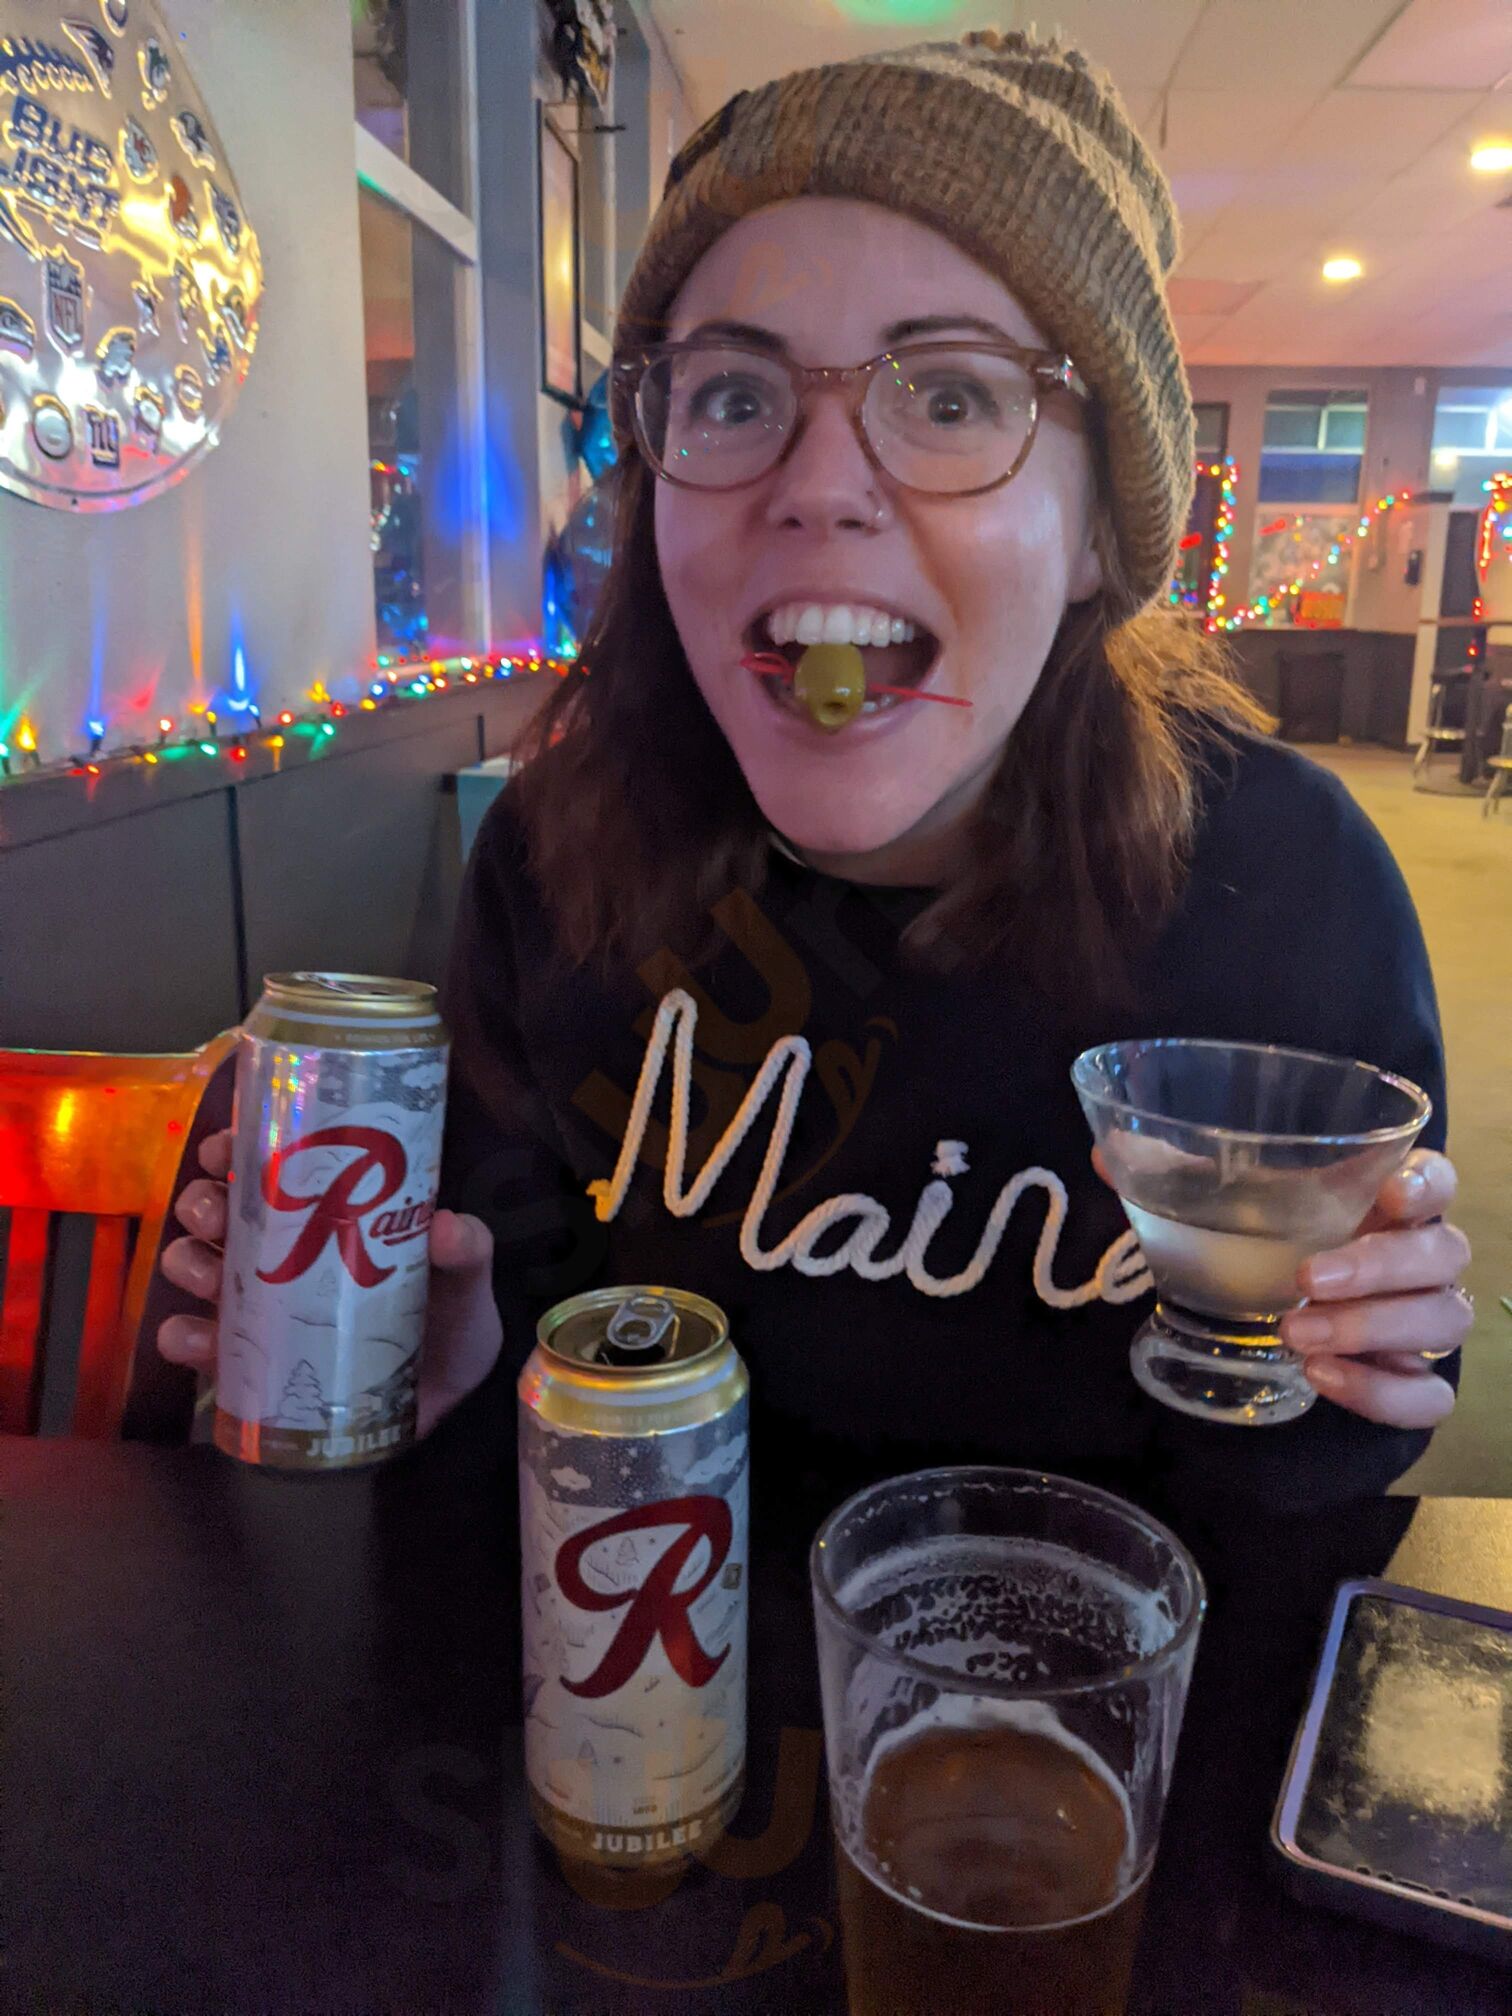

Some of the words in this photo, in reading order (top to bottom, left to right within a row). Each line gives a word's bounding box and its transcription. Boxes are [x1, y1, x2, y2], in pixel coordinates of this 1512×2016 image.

[10, 96, 115, 182] BUD
[0, 147, 121, 229] IGHT
[586, 988, 1156, 1308] Maine
[592, 1819, 702, 1853] JUBILEE
